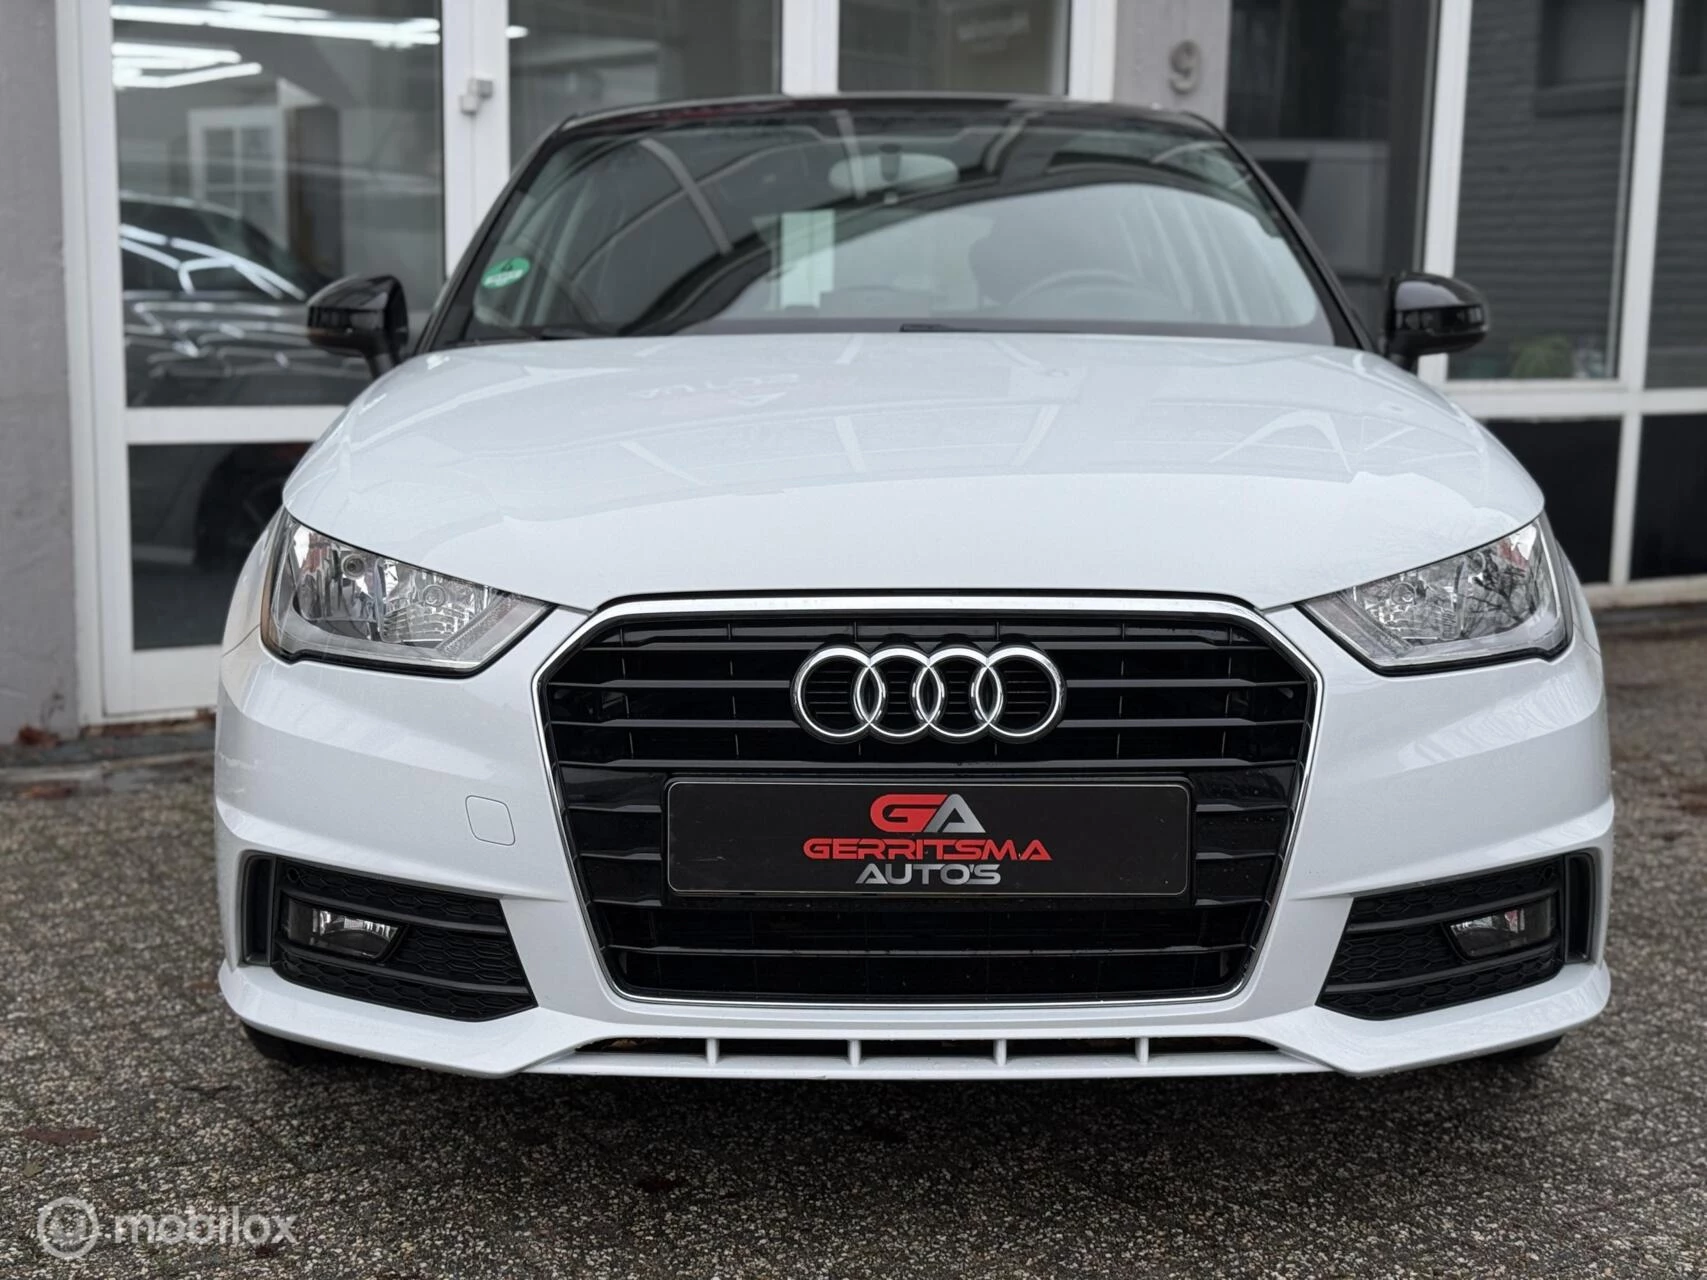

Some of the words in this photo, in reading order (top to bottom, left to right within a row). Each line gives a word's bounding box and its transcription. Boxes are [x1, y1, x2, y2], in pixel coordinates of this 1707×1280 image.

[1168, 40, 1201, 98] 9
[870, 793, 986, 833] GA
[803, 838, 1053, 861] GERRITSMA
[855, 863, 1002, 885] AUTO'S
